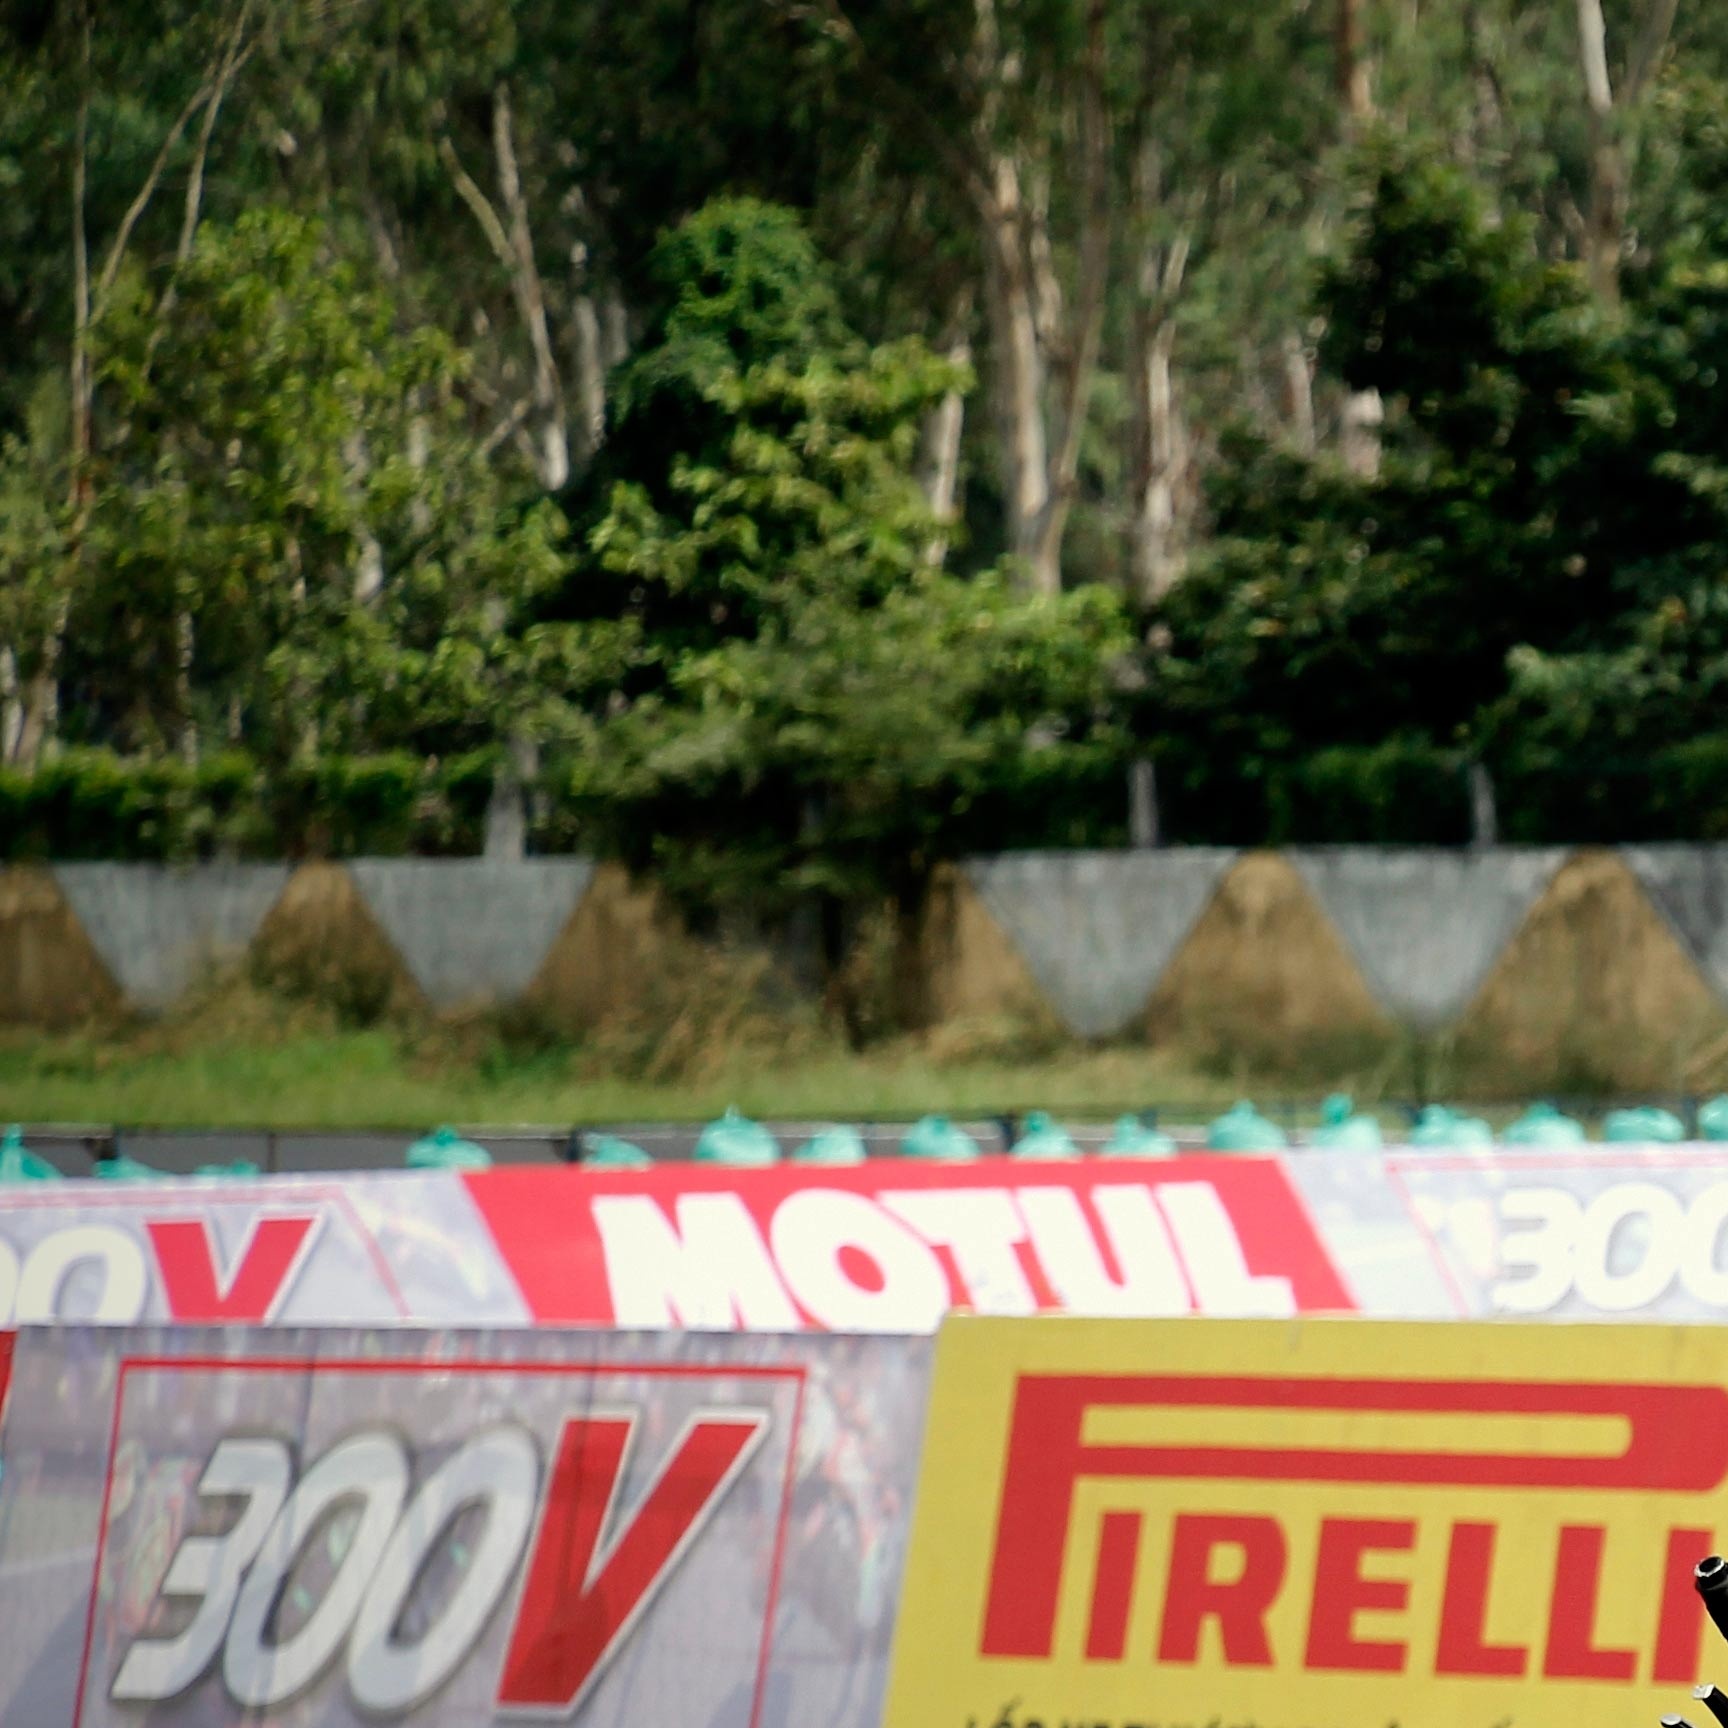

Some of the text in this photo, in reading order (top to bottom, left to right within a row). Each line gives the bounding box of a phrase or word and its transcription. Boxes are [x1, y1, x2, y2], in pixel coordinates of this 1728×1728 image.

[0, 1212, 325, 1328] 0V
[592, 1180, 1296, 1334] MOTUL
[110, 1406, 770, 1722] 300V
